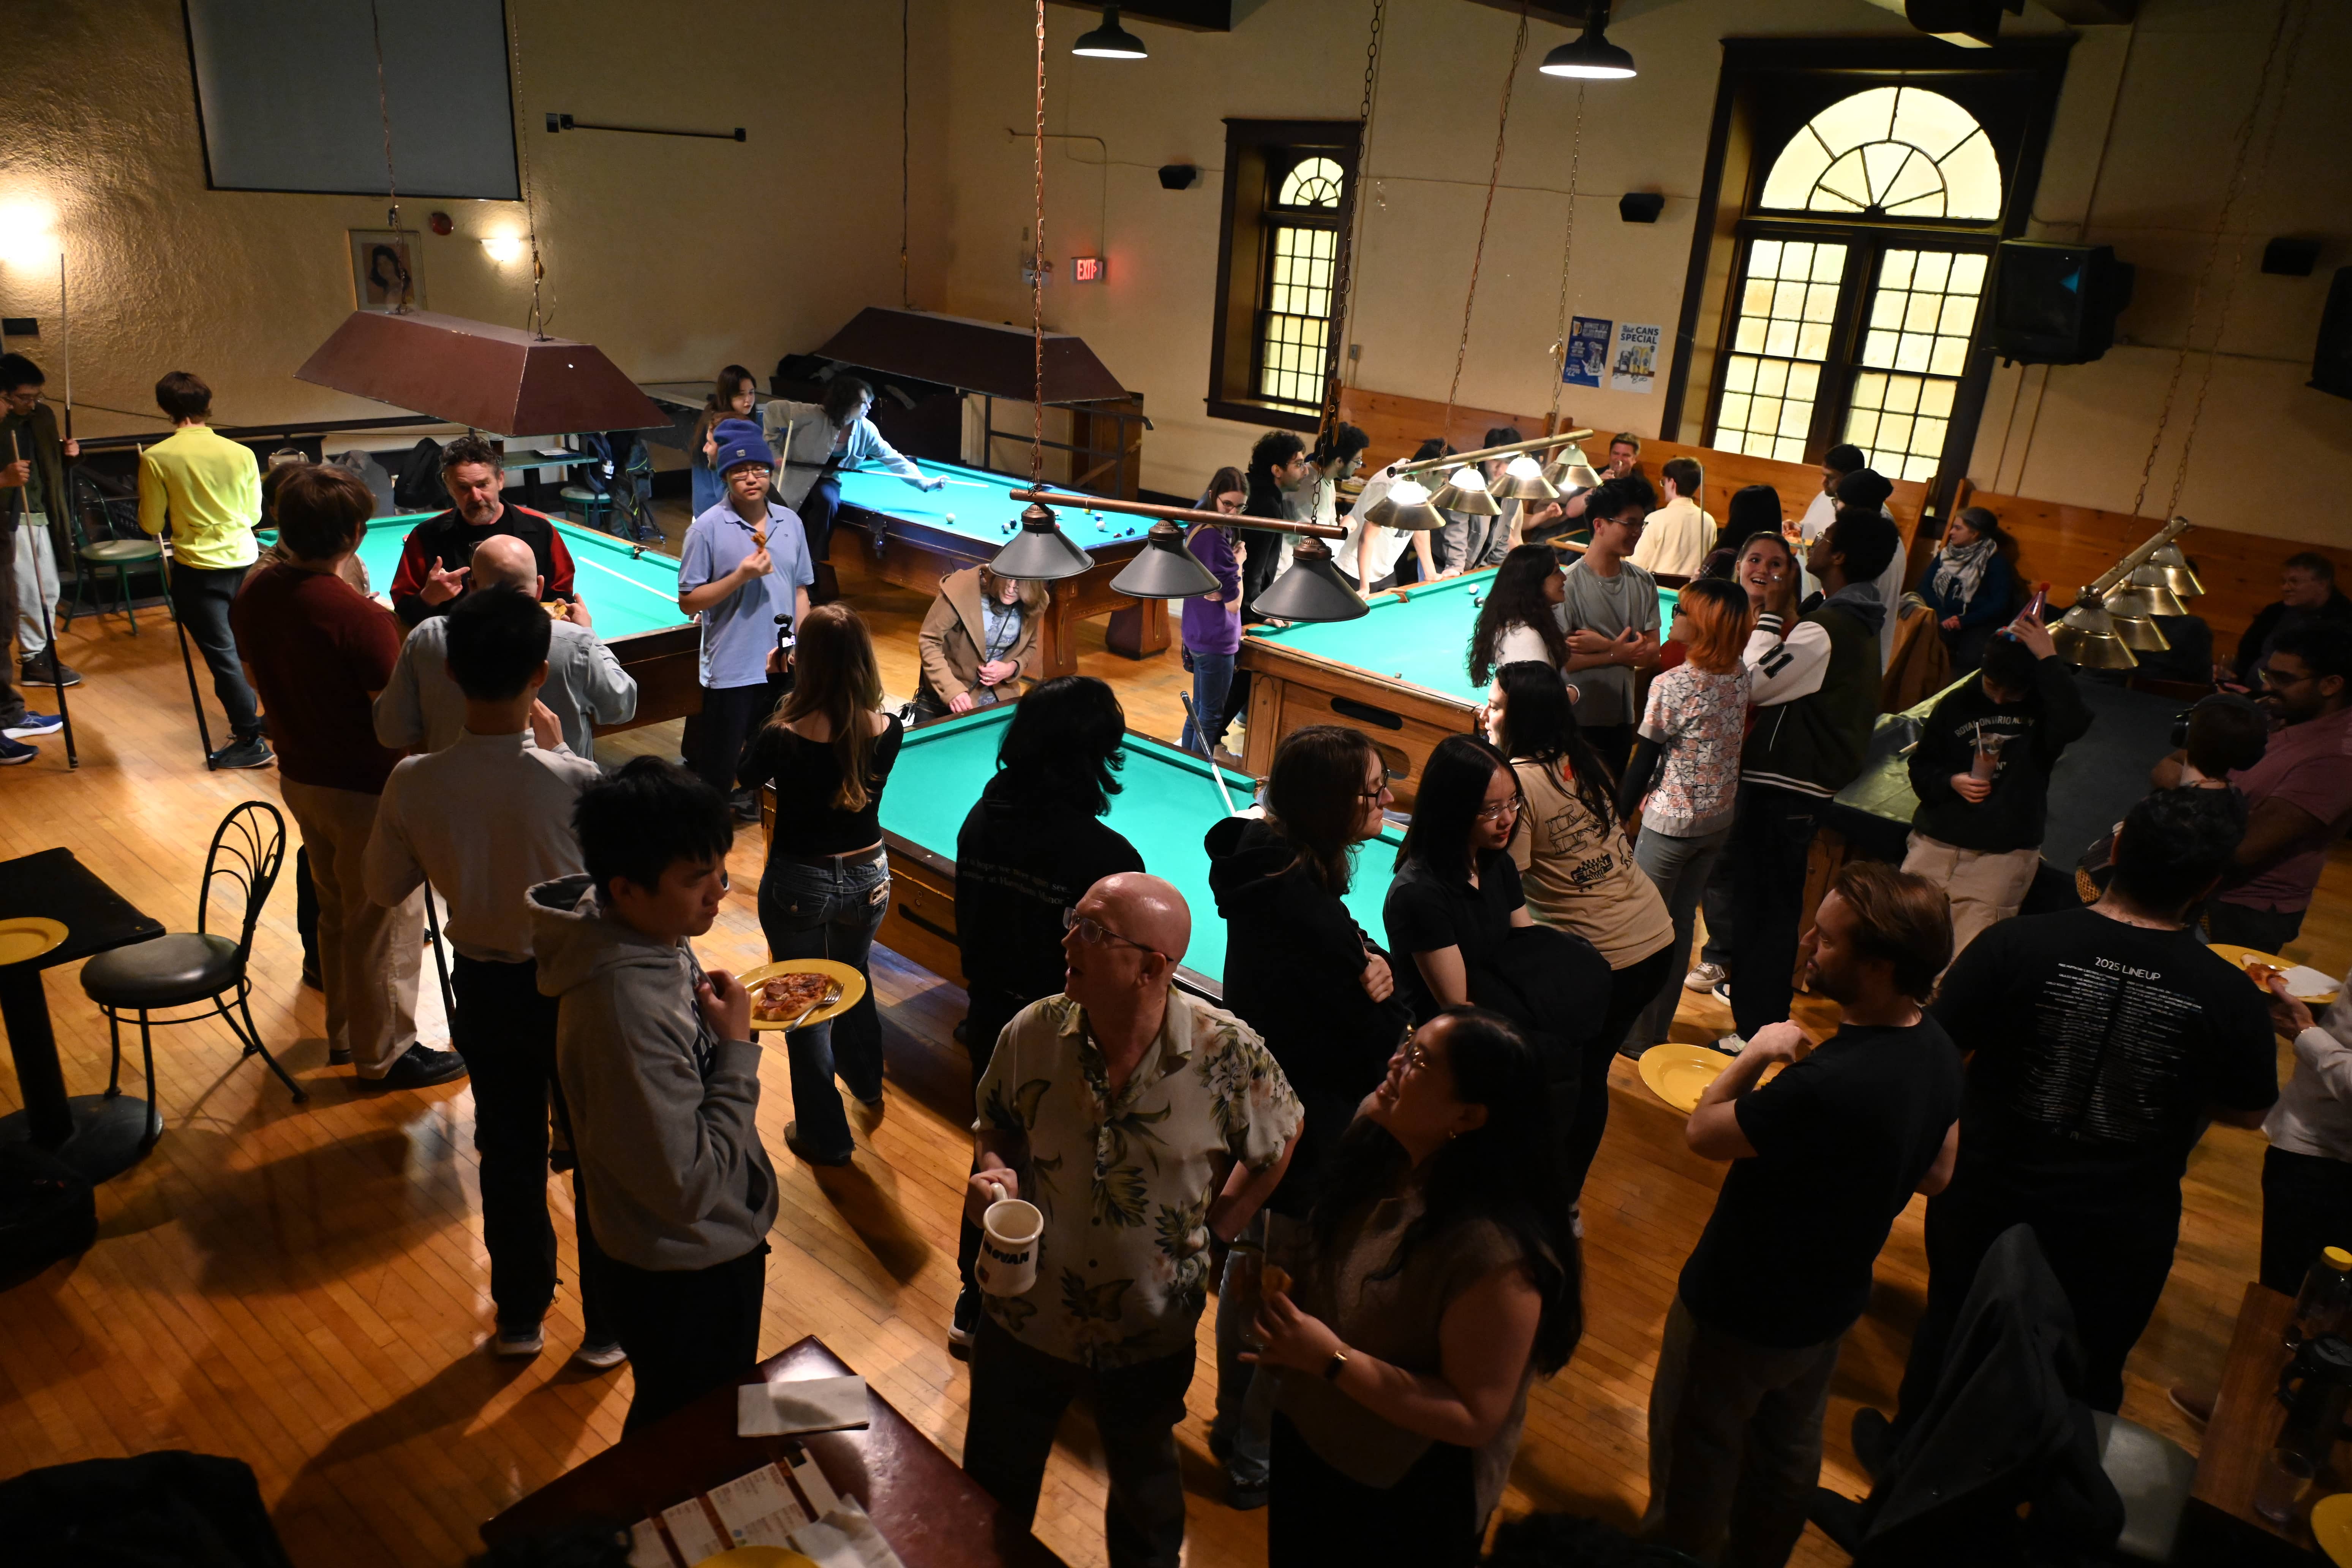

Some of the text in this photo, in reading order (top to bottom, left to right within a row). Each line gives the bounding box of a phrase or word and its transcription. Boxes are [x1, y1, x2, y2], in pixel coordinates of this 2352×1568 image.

[1077, 259, 1095, 280] EXIT
[1620, 334, 1657, 344] SPECIAL
[1636, 327, 1659, 336] CANS
[1954, 720, 1977, 738] ROYAL
[999, 865, 1011, 874] we
[1573, 859, 1612, 880] FINAL
[2095, 957, 2161, 981] 2025 LINEUP
